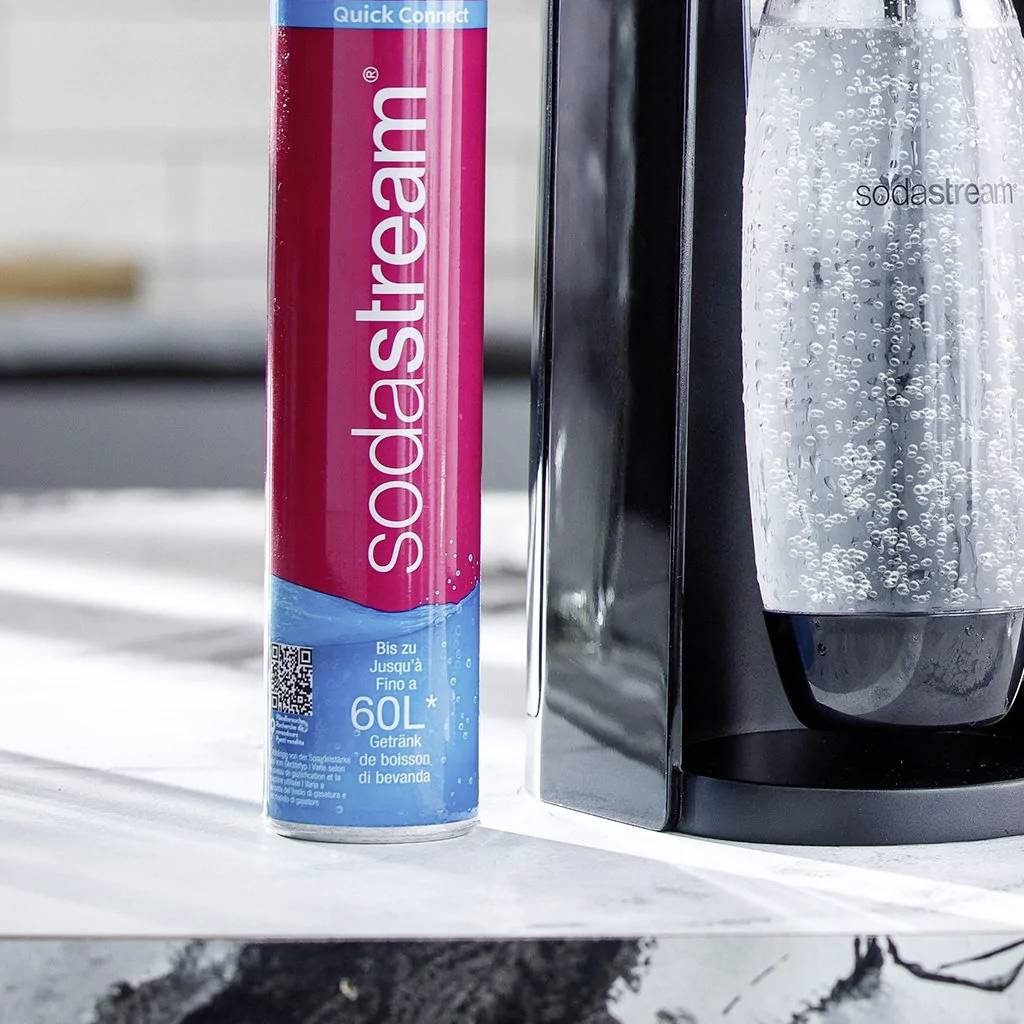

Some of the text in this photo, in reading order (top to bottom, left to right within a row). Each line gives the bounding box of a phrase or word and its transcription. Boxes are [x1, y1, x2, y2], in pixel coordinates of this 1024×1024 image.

[333, 5, 470, 25] Quick Connect
[855, 177, 1015, 207] sodastream
[350, 86, 428, 574] sodastream
[376, 641, 417, 655] Bis zu
[369, 658, 423, 675] Jusqu'à
[376, 677, 417, 691] Fino a
[369, 734, 422, 748] Getränk
[359, 753, 376, 767] de
[380, 752, 431, 767] boisson
[358, 769, 431, 784] di bevanda
